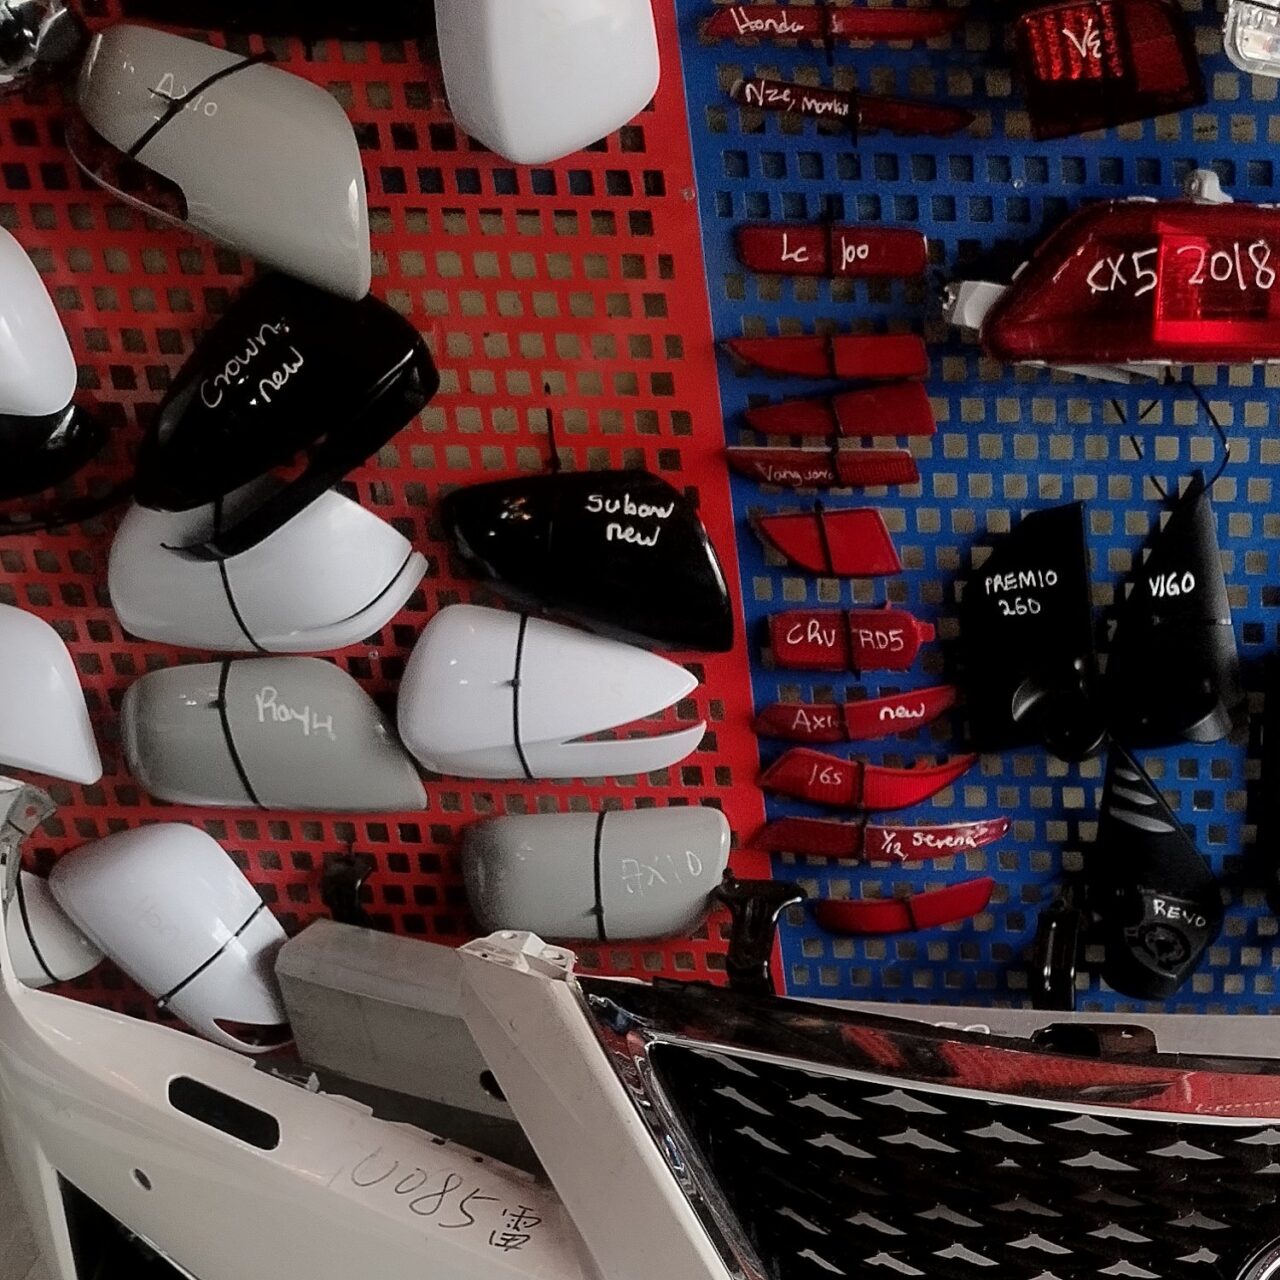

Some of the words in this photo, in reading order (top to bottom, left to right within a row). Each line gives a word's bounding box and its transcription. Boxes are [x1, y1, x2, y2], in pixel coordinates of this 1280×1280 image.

[730, 6, 805, 35] Honda
[841, 236, 870, 271] 100
[1176, 239, 1276, 290] 2018
[200, 323, 280, 408] Crown
[258, 345, 304, 403] new
[606, 522, 661, 547] new
[985, 569, 1058, 595] PREMIO
[1149, 571, 1196, 597] VIGO
[998, 597, 1041, 616] 260
[859, 629, 904, 651] RD5
[879, 703, 926, 721] new
